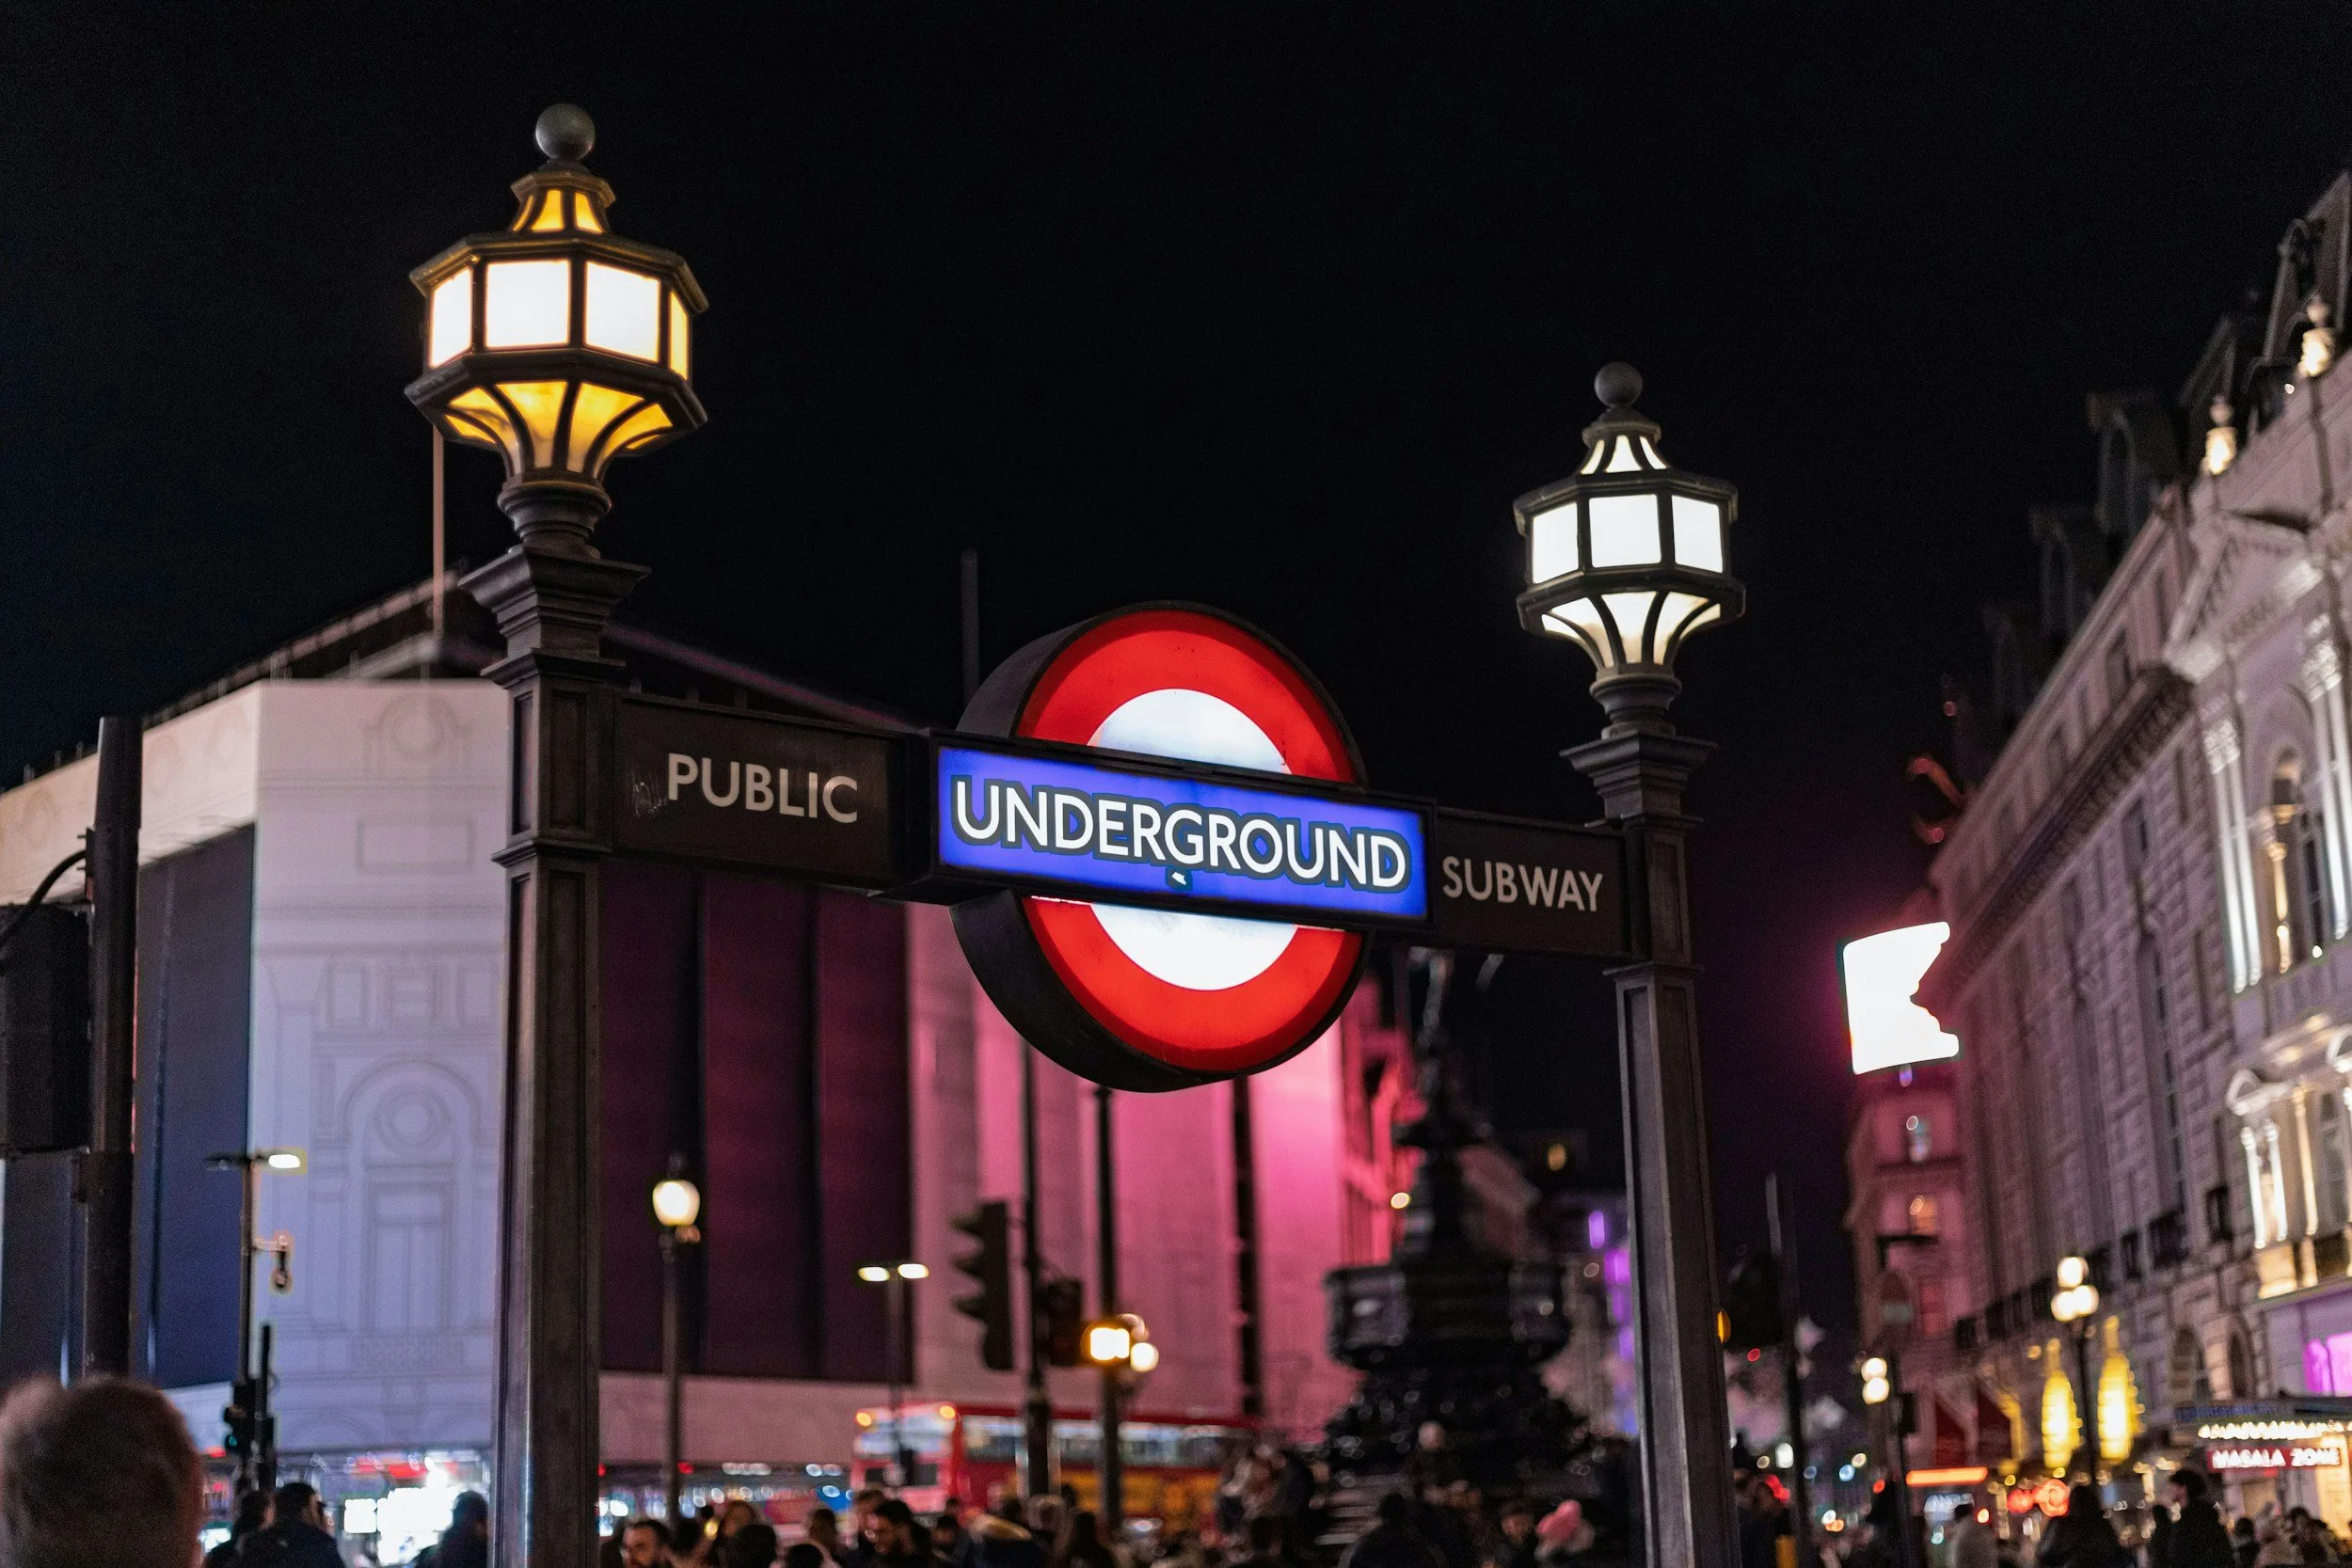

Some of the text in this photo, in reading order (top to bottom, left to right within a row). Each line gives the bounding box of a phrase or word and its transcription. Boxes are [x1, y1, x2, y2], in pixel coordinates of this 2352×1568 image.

[668, 752, 858, 823] PUBLIC
[957, 781, 1406, 887] UNDERGROUND
[1442, 856, 1603, 911] SUBWAY
[2212, 1448, 2340, 1468] MASALA ZONE
